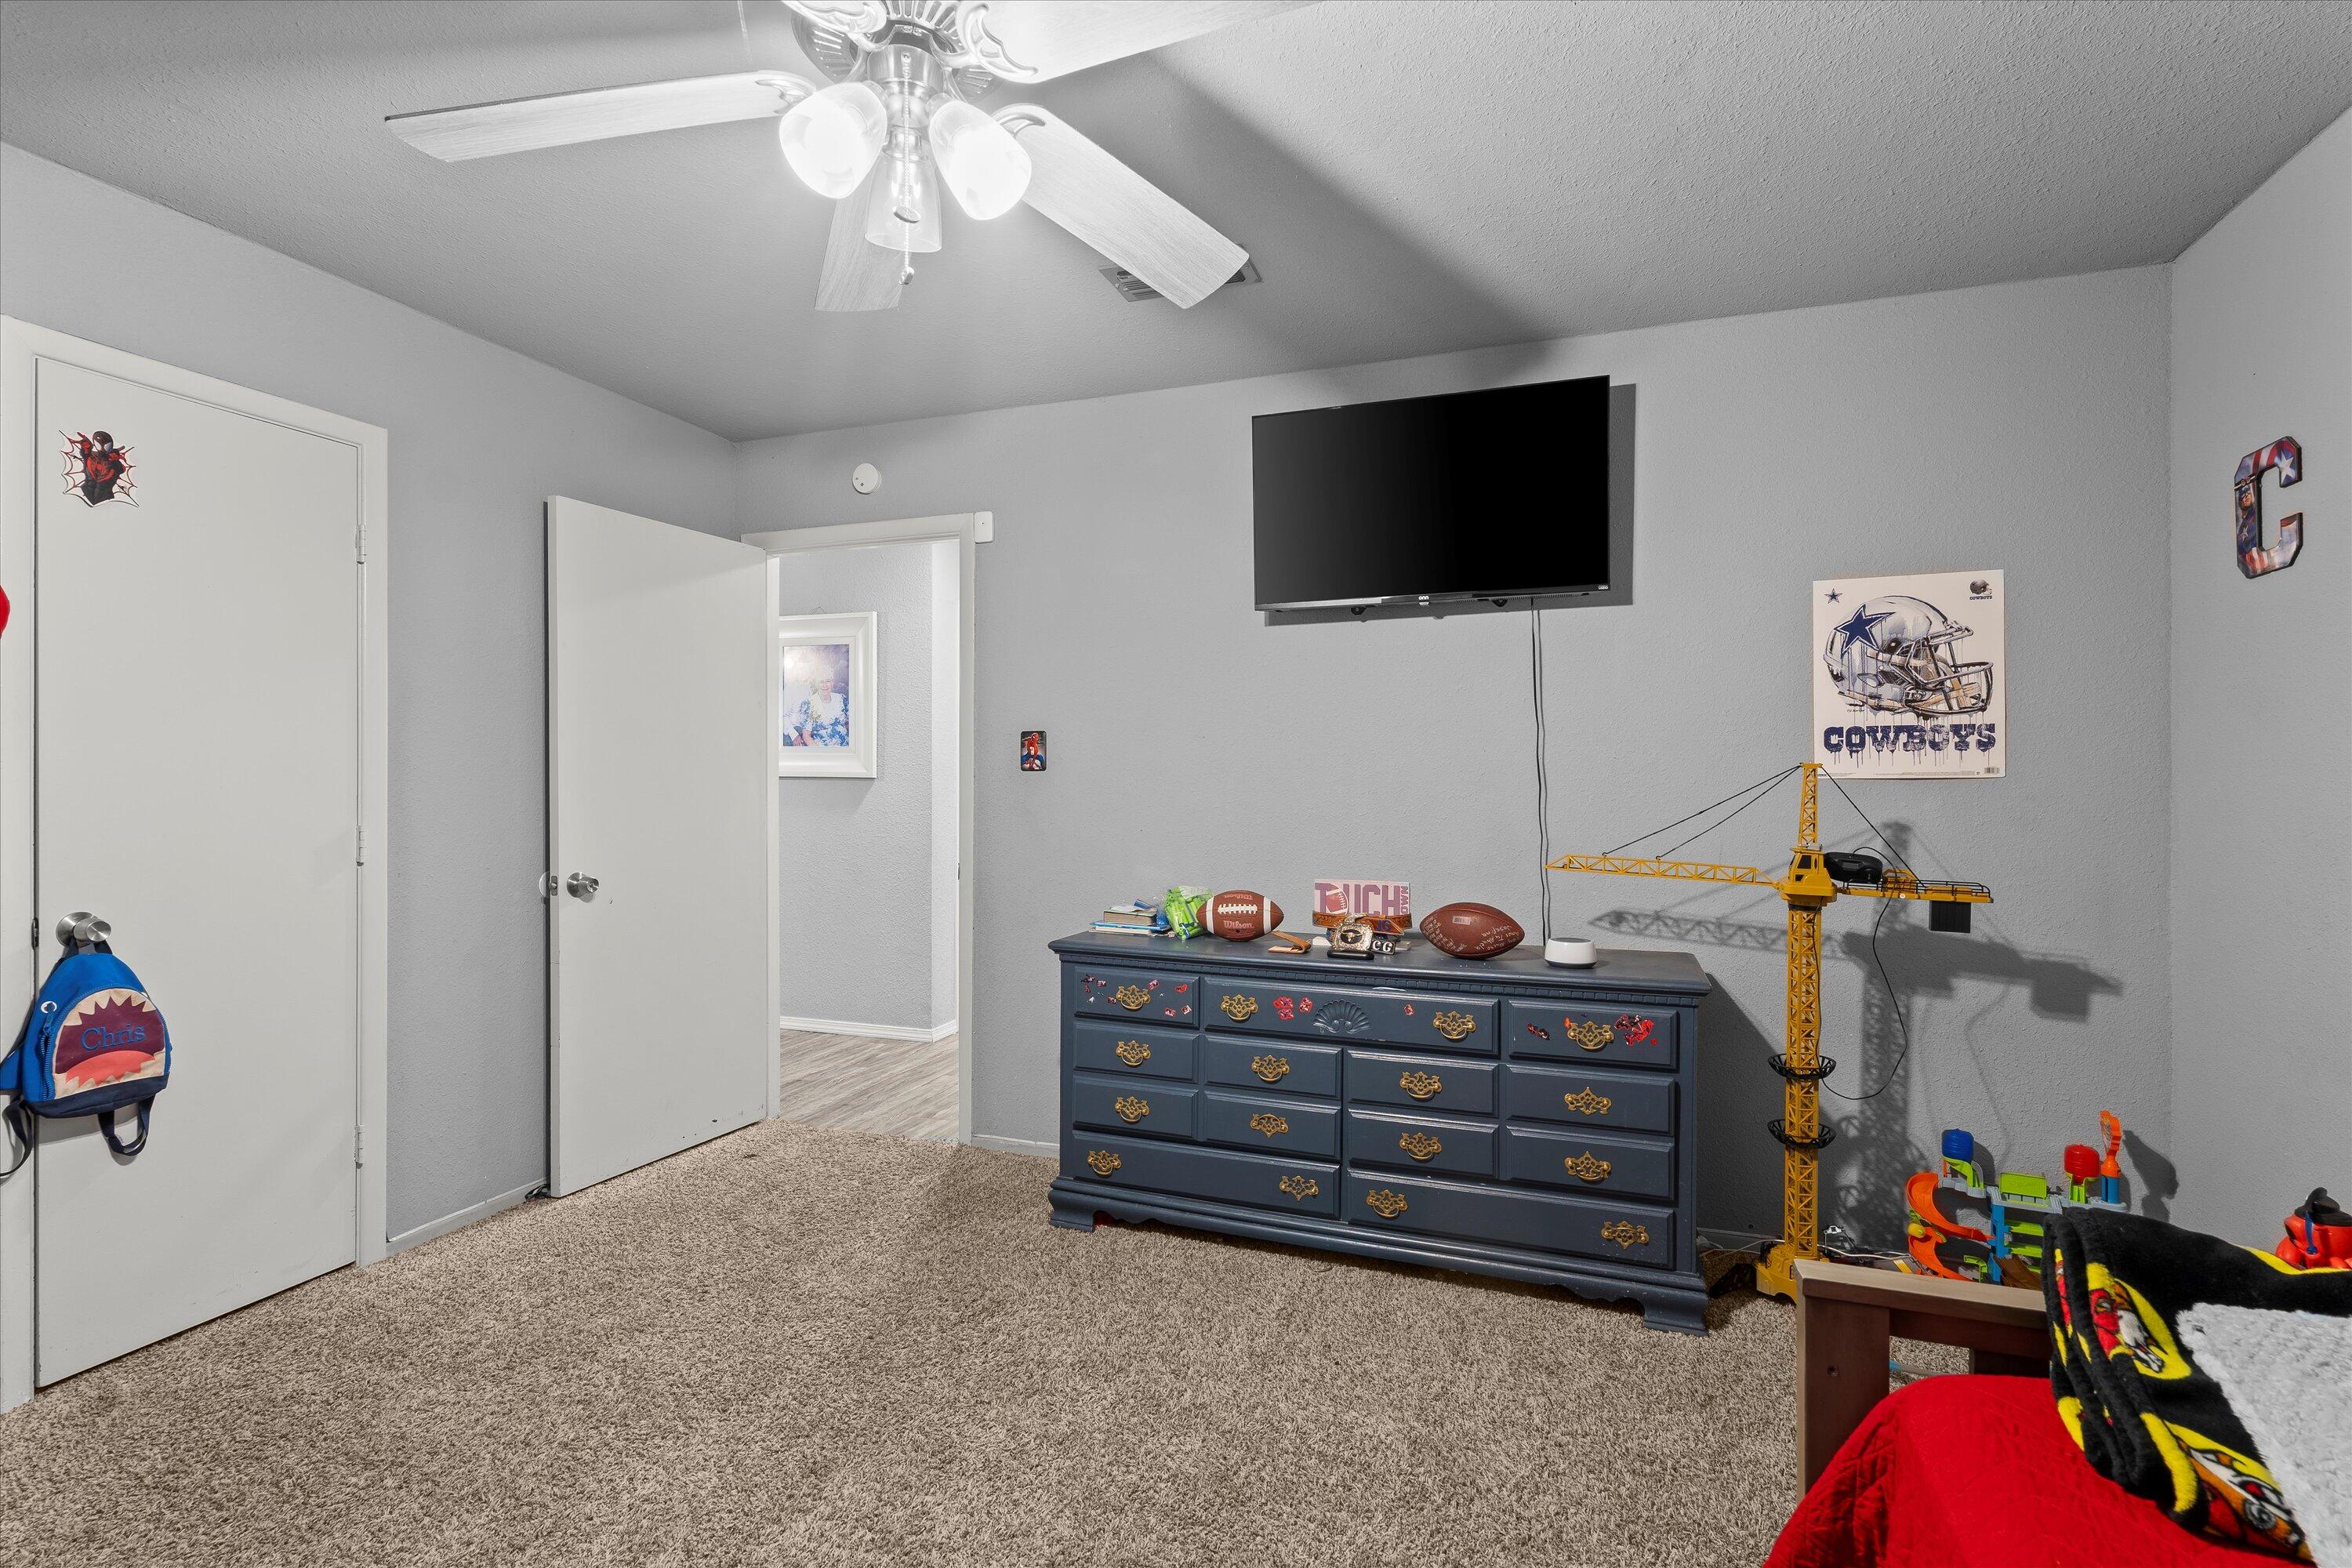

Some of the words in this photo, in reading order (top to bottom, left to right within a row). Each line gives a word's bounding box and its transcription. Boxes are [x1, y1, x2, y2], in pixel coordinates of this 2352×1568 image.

[1824, 723, 1996, 752] COWBOYS
[1223, 920, 1254, 929] Wilson
[82, 1023, 145, 1051] Chris
